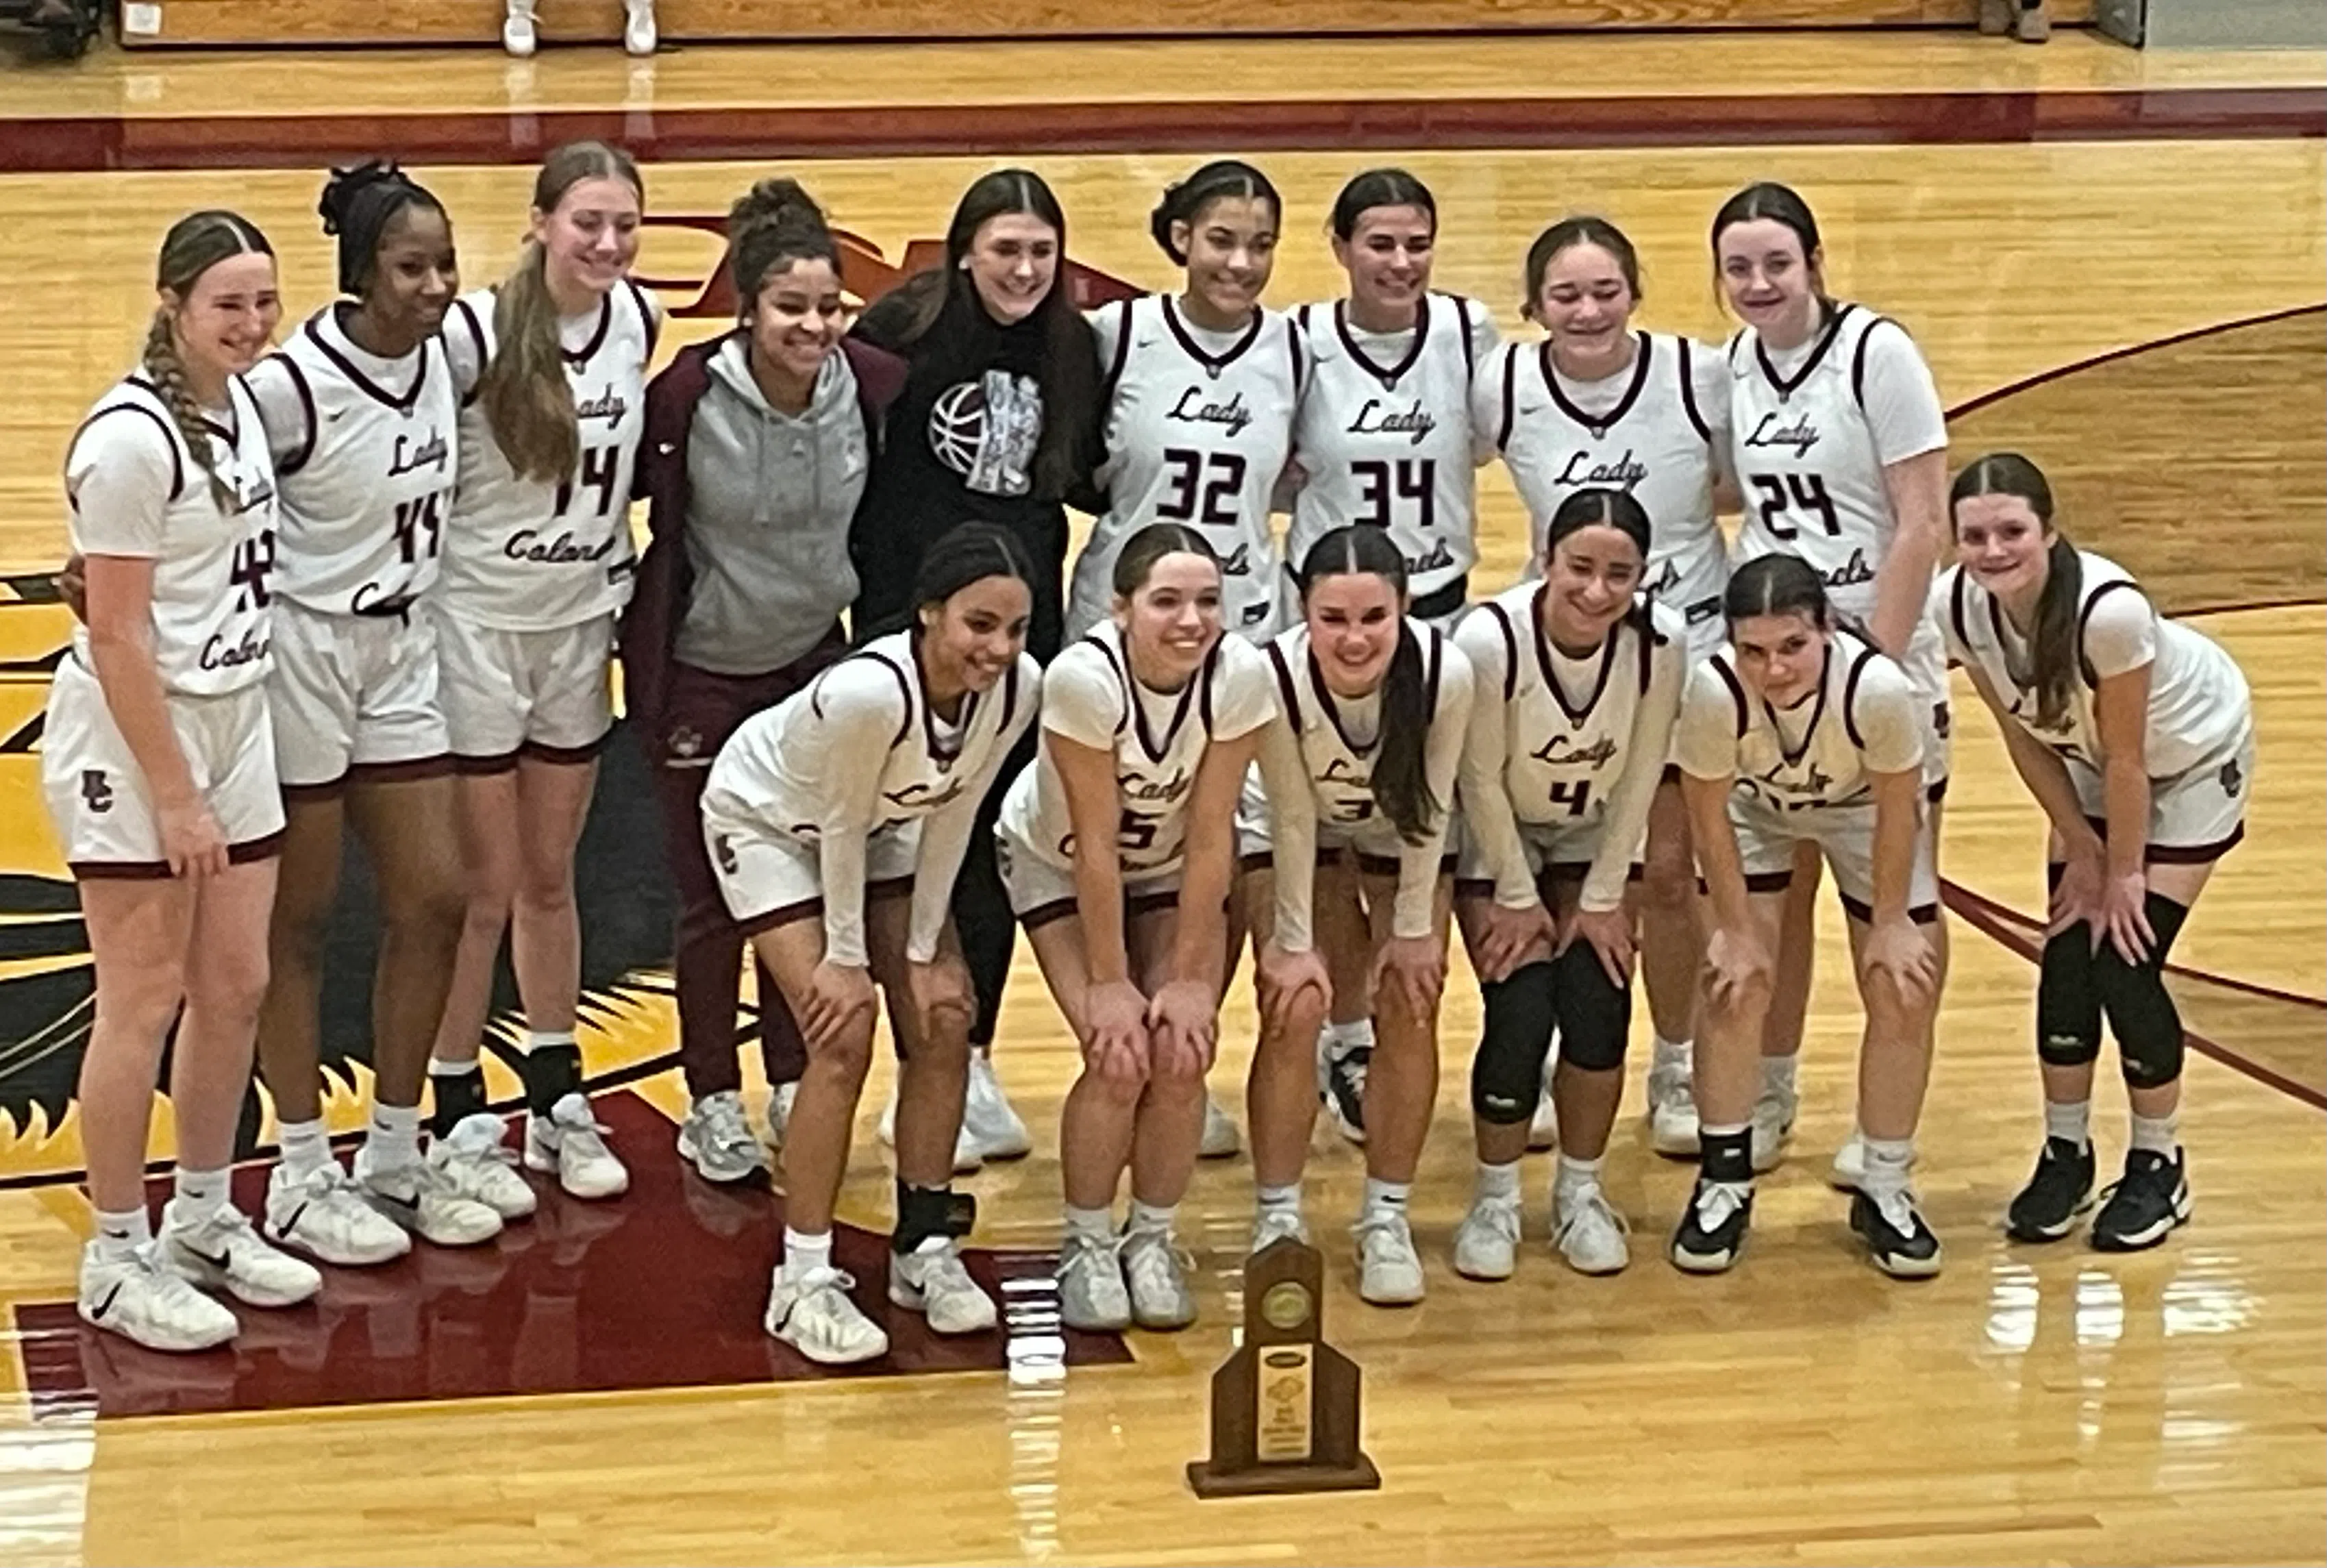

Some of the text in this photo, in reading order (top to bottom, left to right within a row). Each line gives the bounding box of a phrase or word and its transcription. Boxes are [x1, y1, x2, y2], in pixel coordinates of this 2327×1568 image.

[577, 383, 627, 430] ady
[1164, 385, 1254, 437] Lady
[1346, 399, 1437, 445] Lady
[1744, 412, 1821, 460] Lady
[1156, 448, 1247, 525] 32
[1349, 458, 1436, 528] 34
[1554, 449, 1650, 493] Lady
[1748, 473, 1842, 541] 24
[1530, 730, 1617, 771] Lady
[1549, 780, 1591, 816] 4
